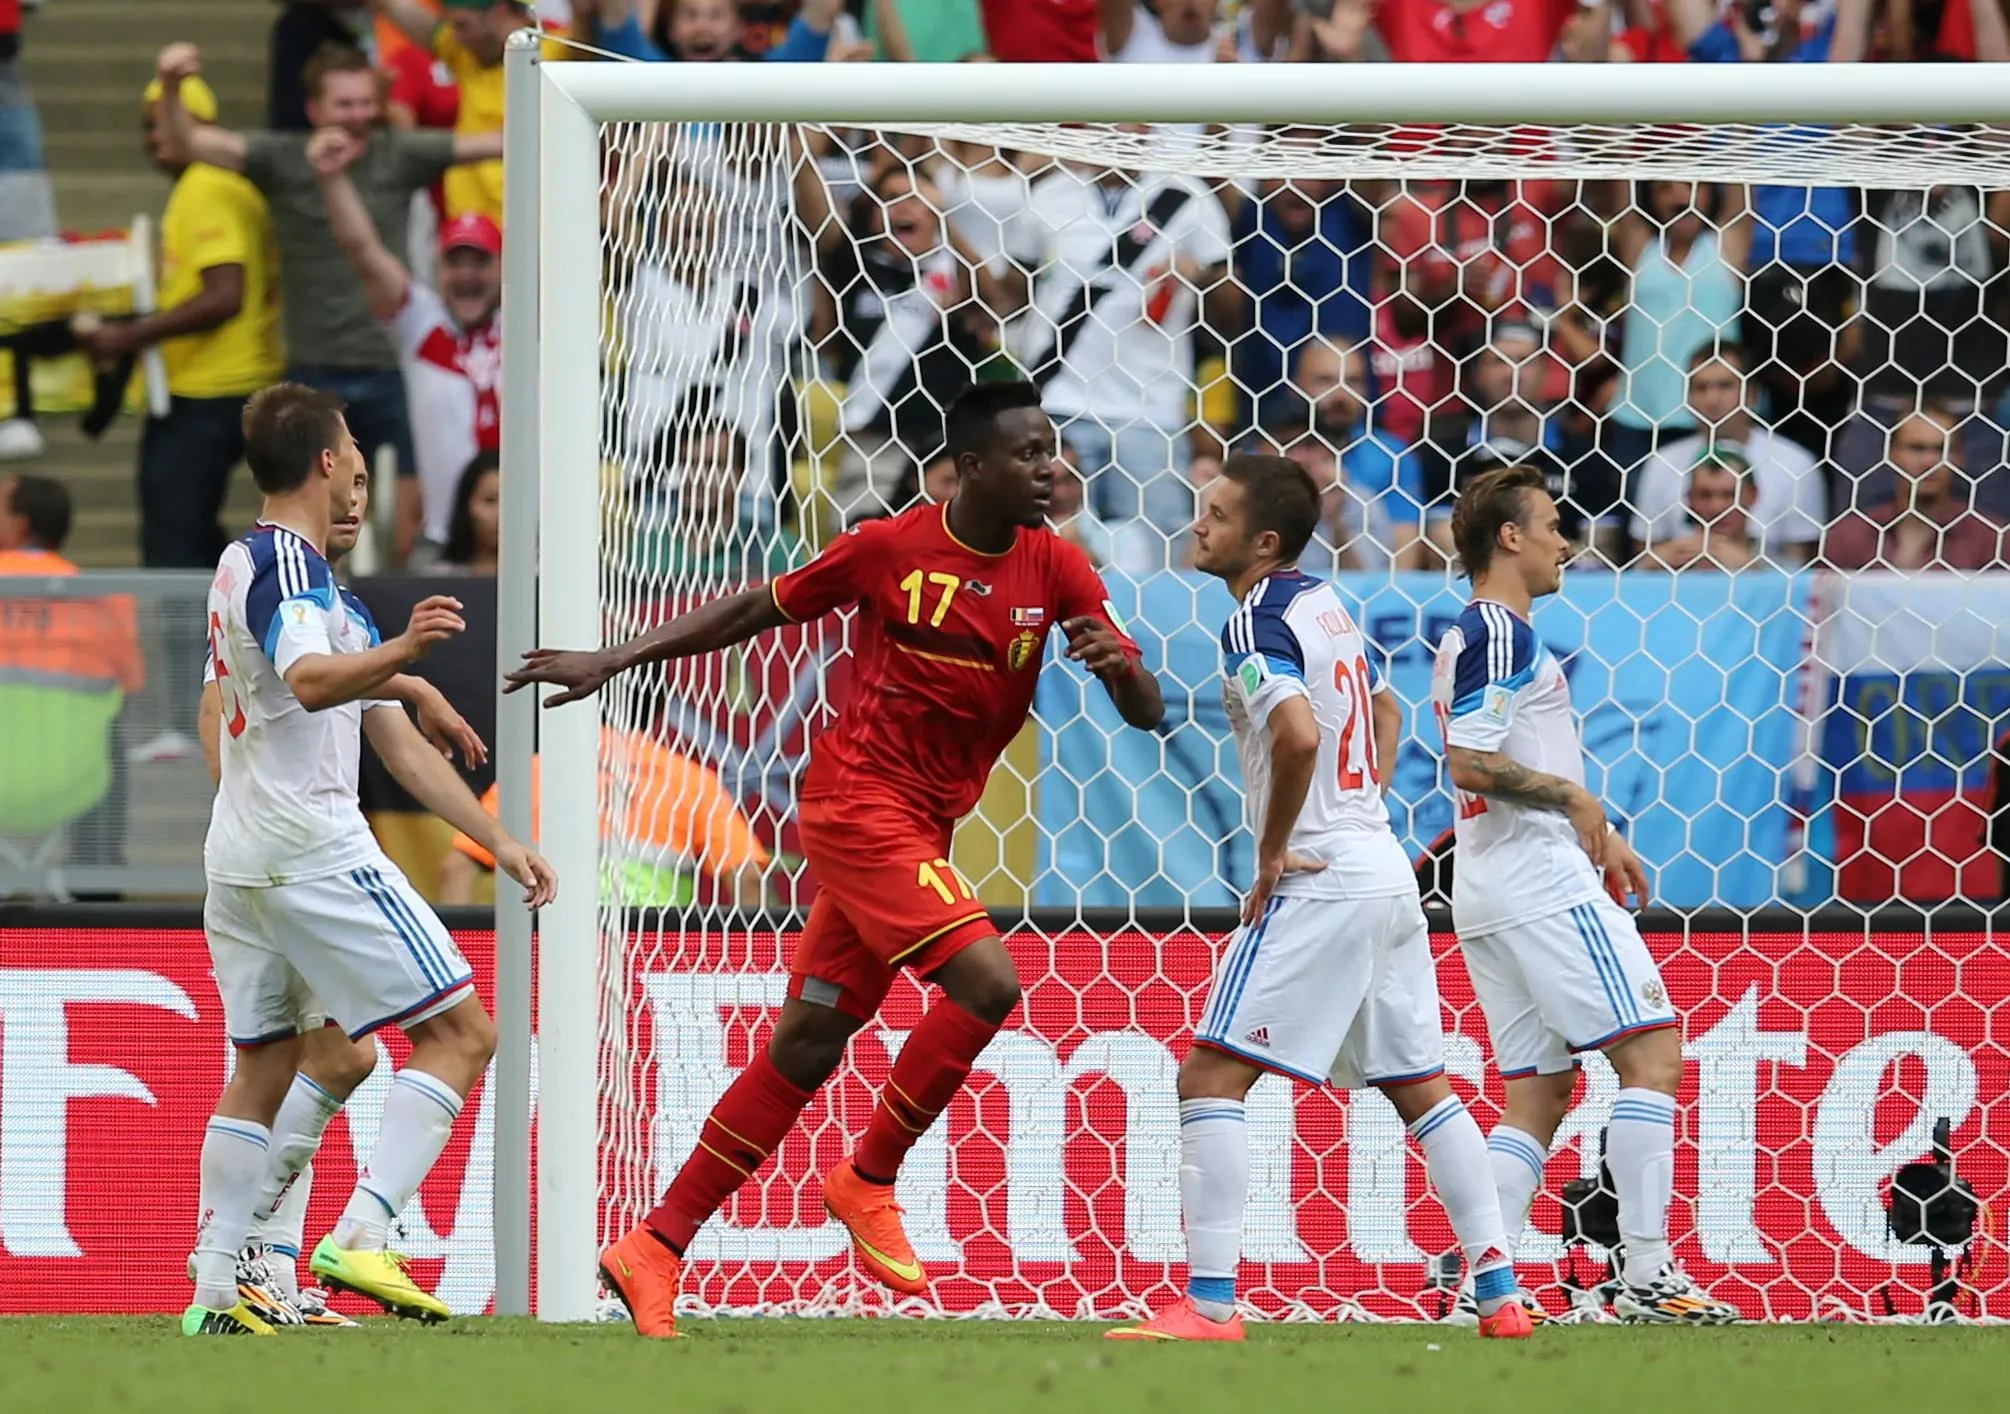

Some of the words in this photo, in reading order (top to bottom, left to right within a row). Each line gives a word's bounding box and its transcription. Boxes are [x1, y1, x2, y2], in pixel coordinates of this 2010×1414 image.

[900, 569, 960, 627] 17
[1334, 654, 1381, 791] 20
[918, 857, 972, 905] 17
